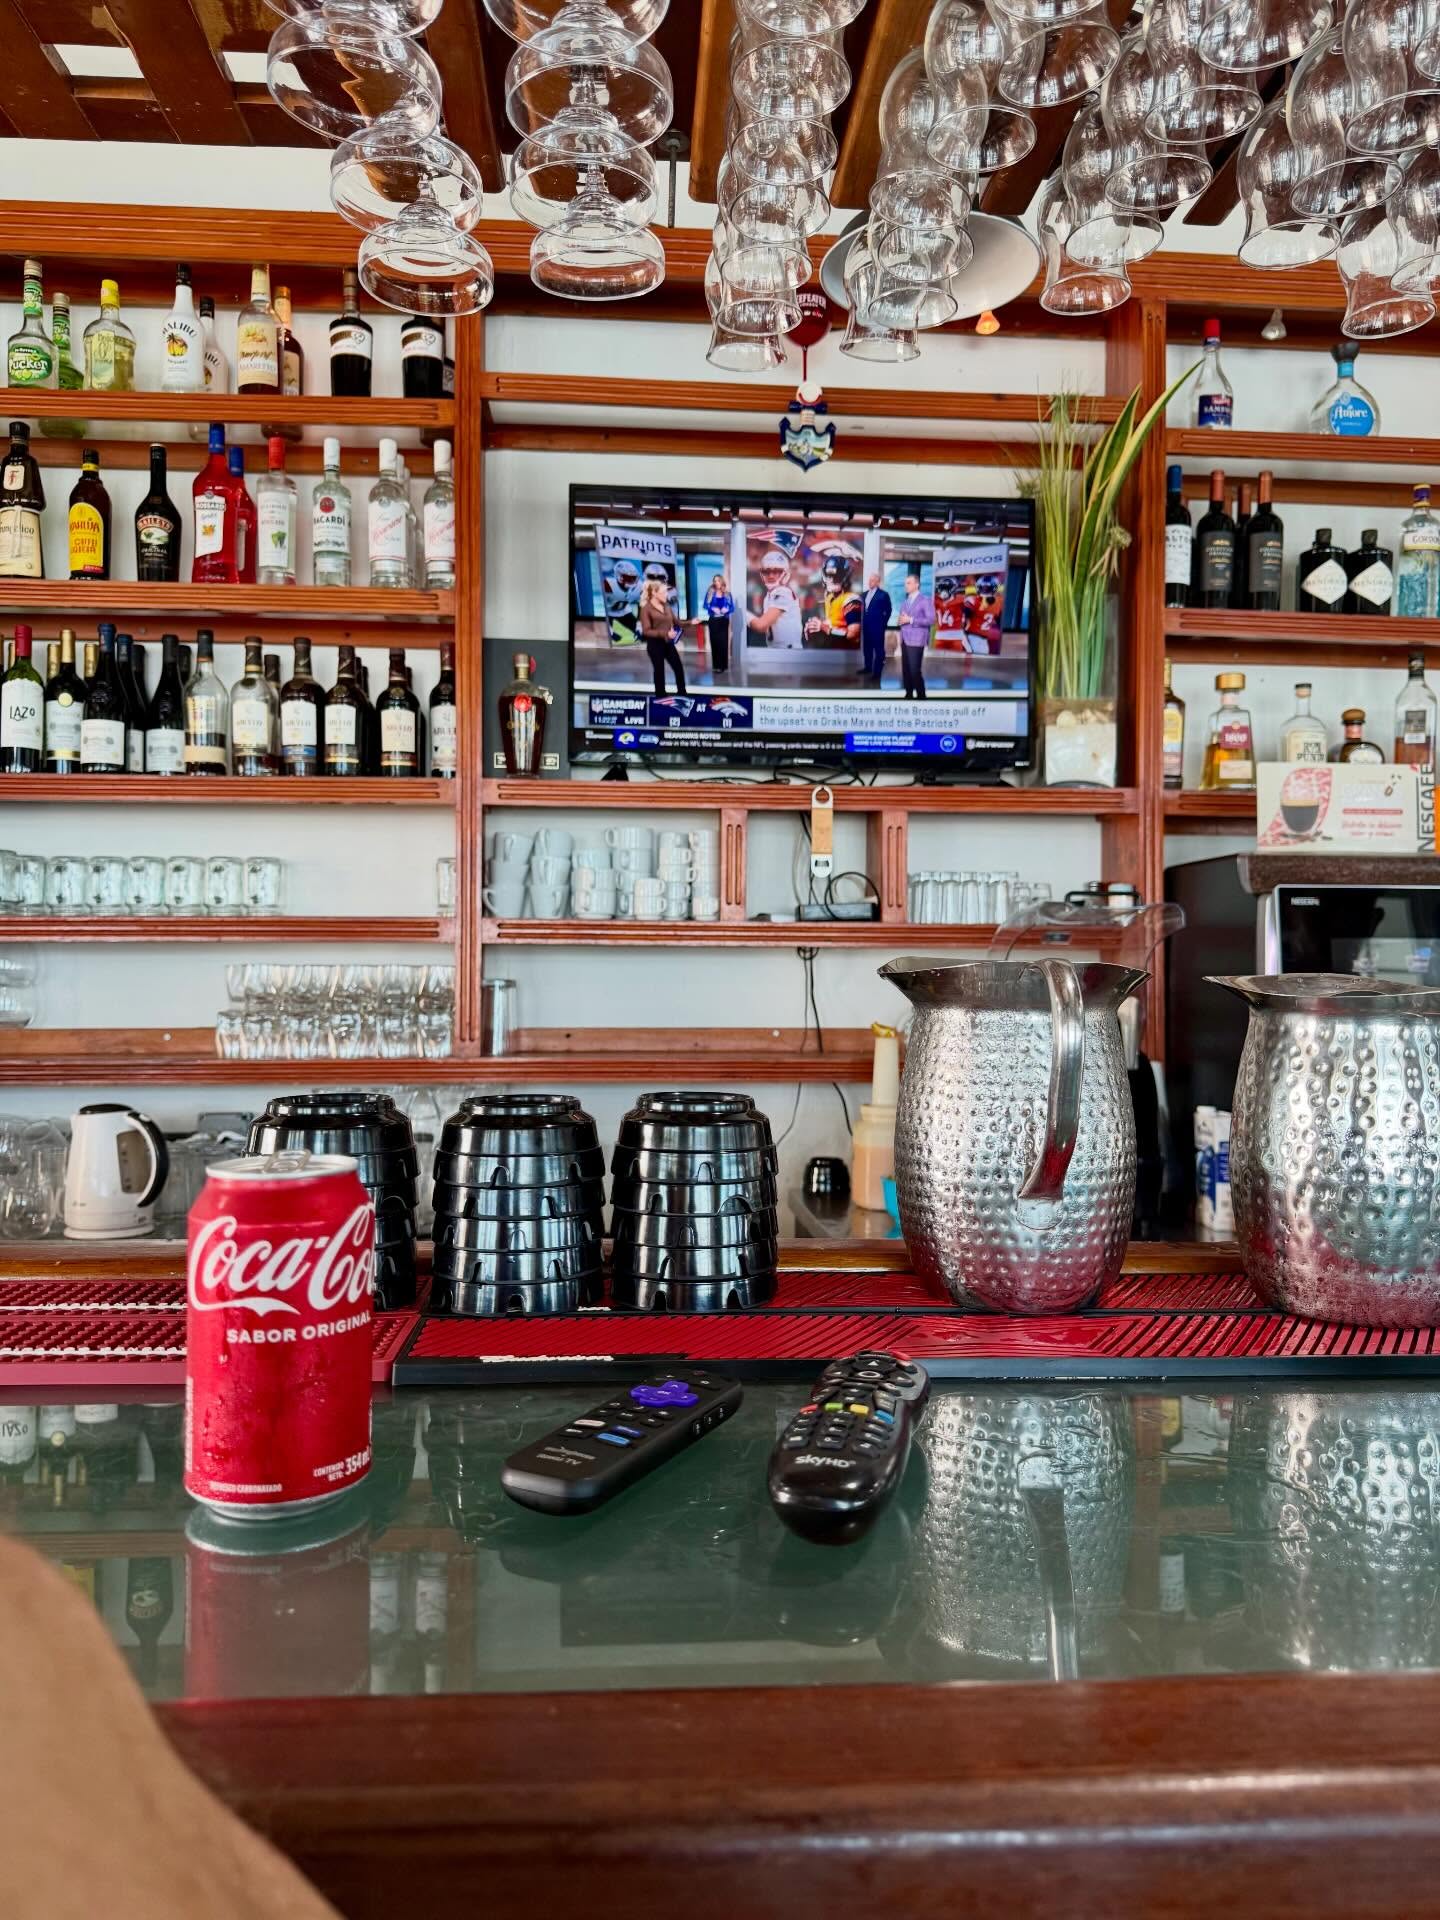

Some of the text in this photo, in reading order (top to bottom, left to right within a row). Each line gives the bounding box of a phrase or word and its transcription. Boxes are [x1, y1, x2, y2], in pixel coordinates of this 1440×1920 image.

[601, 534, 672, 557] PATRIOTS
[937, 555, 1003, 569] BRONCOS
[981, 613, 994, 631] 2
[9, 705, 36, 721] LAZO
[696, 703, 706, 713] AT
[760, 704, 986, 717] How do Jarrett Stidham and the Broncos pull off
[760, 716, 776, 725] the
[778, 717, 804, 727] upset
[821, 717, 848, 727] Drake
[850, 717, 874, 728] Maye
[879, 718, 894, 728] and
[896, 718, 912, 728] the
[226, 1309, 371, 1344] SABOR ORIGINAL
[345, 1453, 362, 1476] 354
